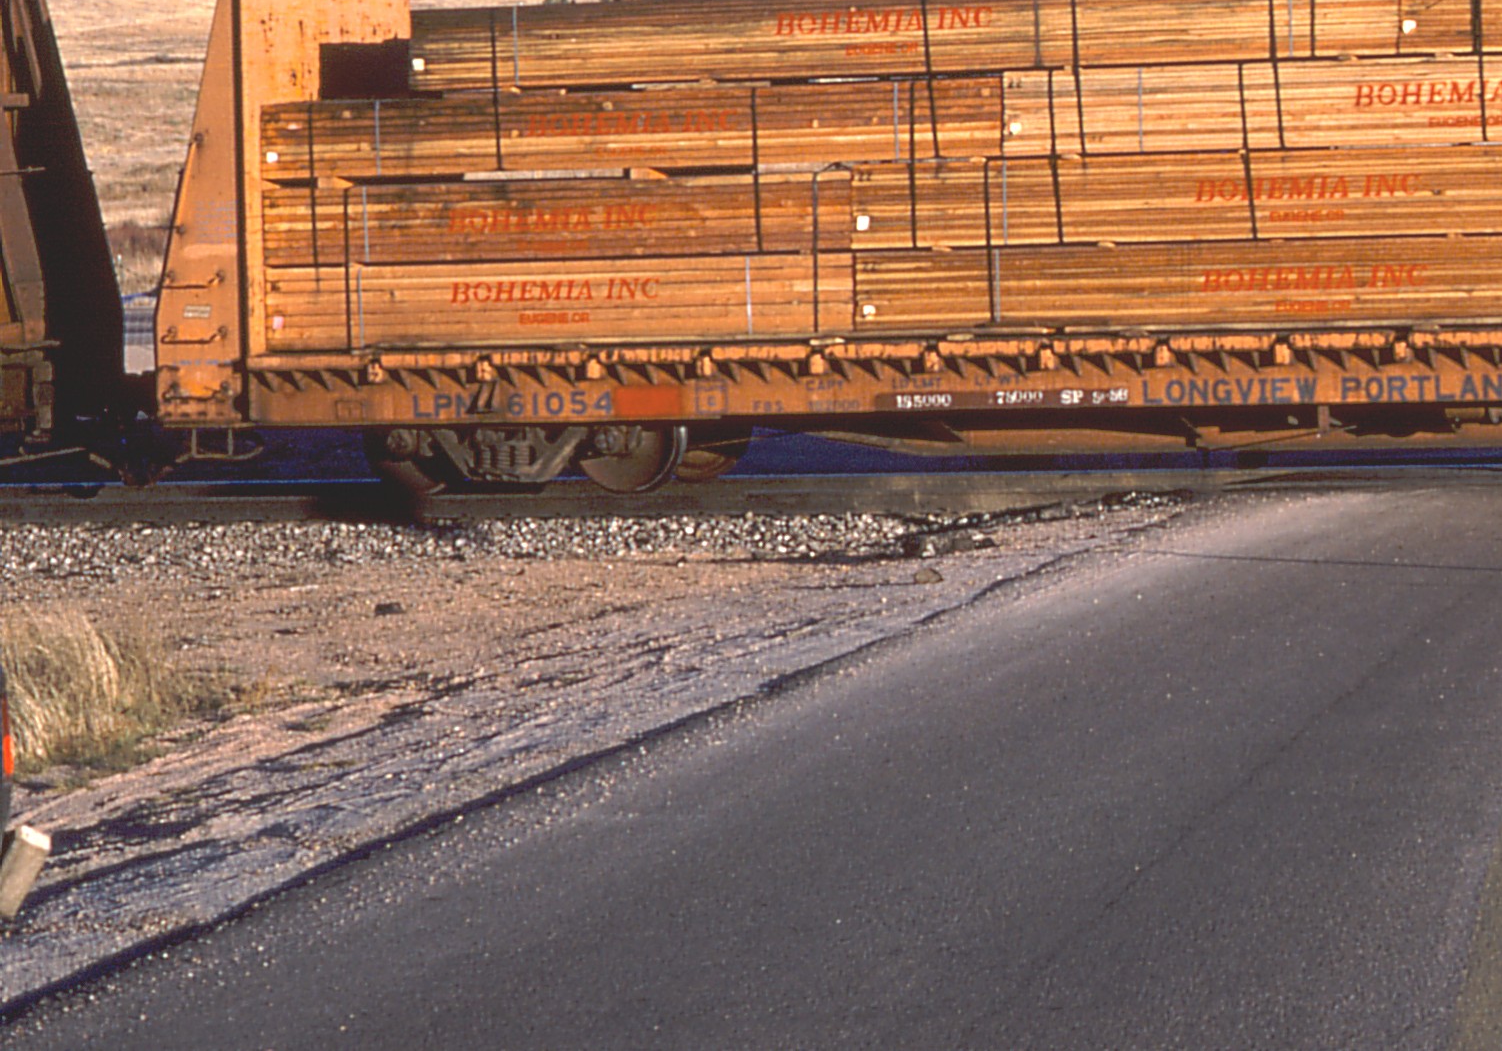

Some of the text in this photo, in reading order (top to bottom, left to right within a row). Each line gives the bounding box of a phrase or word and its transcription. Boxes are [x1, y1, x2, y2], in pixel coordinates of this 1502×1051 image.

[775, 6, 992, 36] BOHEMIA INC
[527, 109, 738, 137] BOHEMIA INC
[1195, 174, 1421, 202] BOHEMIA INC
[603, 204, 657, 228] INC
[451, 277, 660, 304] BOHEMIA INC
[1201, 264, 1428, 293] BOHEMIA INC
[507, 391, 613, 416] 61054
[1061, 389, 1084, 405] SP
[1141, 376, 1317, 404] LONGVIEW
